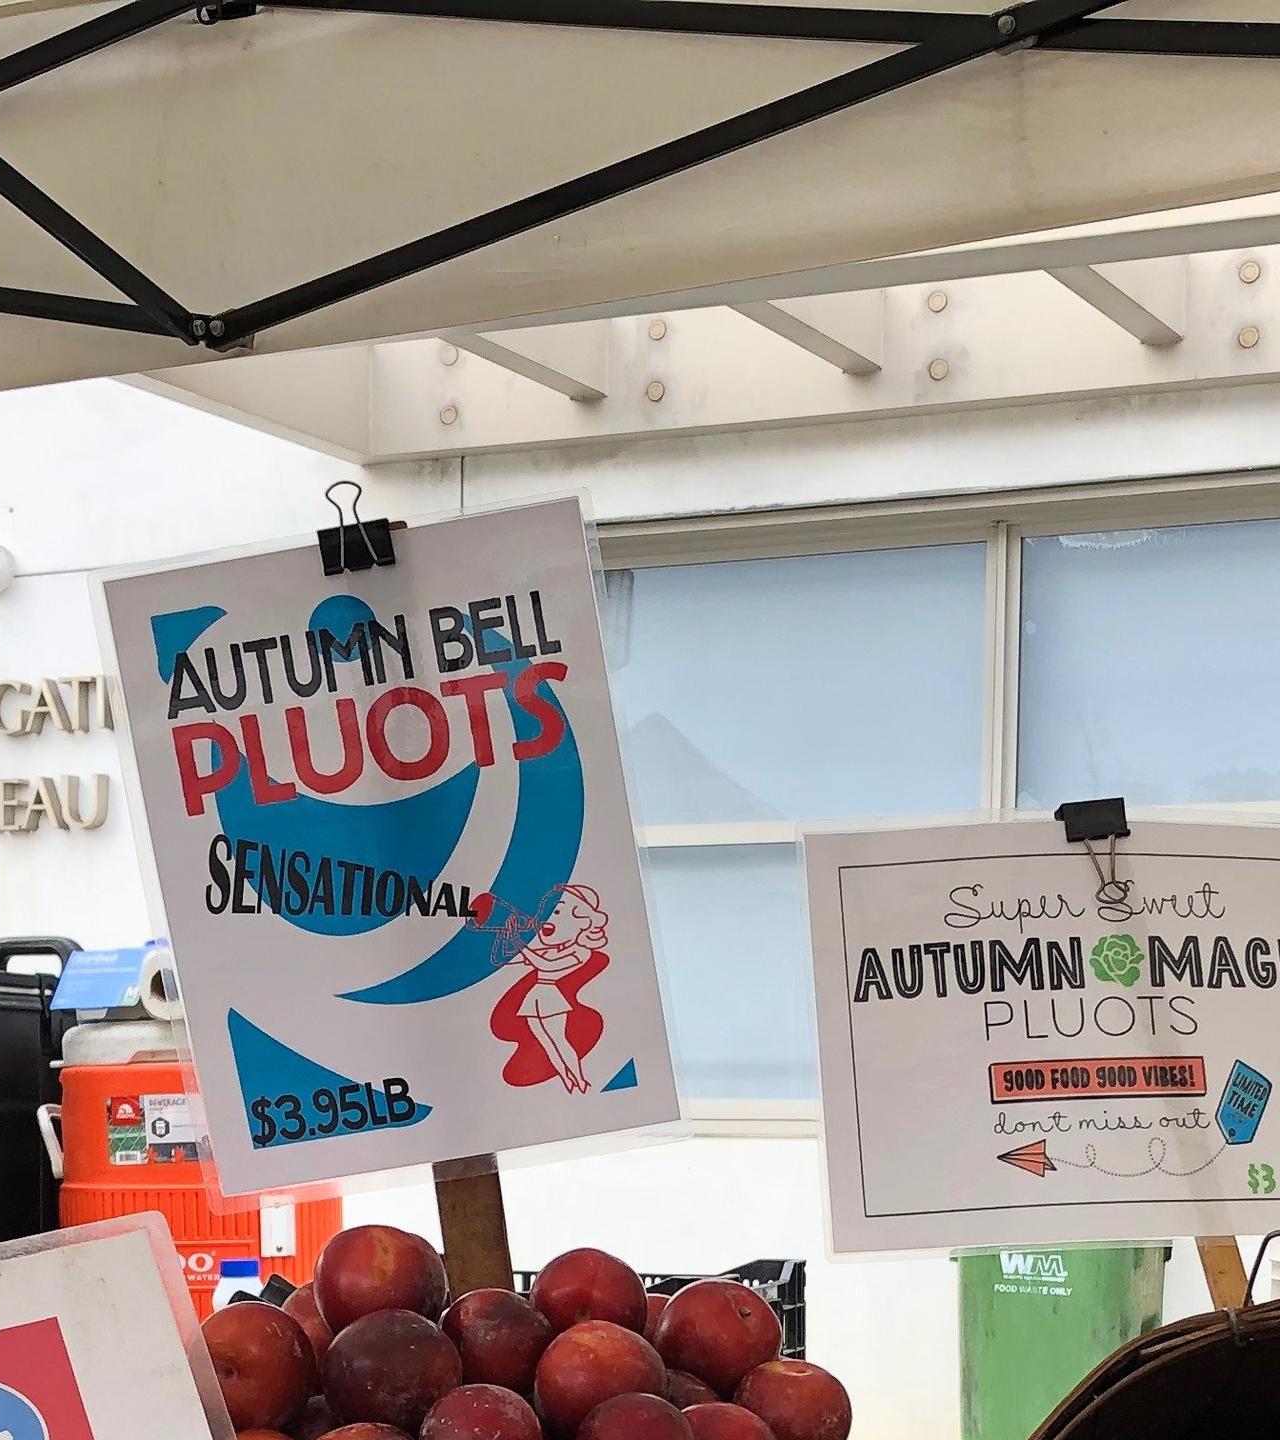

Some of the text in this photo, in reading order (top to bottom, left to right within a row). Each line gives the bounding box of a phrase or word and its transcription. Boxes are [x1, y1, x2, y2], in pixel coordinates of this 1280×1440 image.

[168, 590, 562, 719] AUTUMN BELL
[171, 662, 568, 816] PLUOTS
[205, 834, 479, 918] SENSATIONAL
[944, 880, 1225, 933] Super Sweet
[854, 936, 1082, 1002] AUTUMN
[985, 995, 1198, 1042] PLUOTS
[1051, 1066, 1090, 1089] FOOD
[1142, 1064, 1195, 1087] VIBES!
[1232, 1072, 1268, 1101] LIMITED
[252, 1077, 416, 1149] $3.95LB
[994, 1111, 1072, 1134] dont
[1078, 1110, 1152, 1130] miss
[1159, 1108, 1211, 1129] out
[1227, 1090, 1259, 1118] TIME
[993, 1284, 1018, 1293] FOOD
[1049, 1287, 1072, 1296] ONLY
